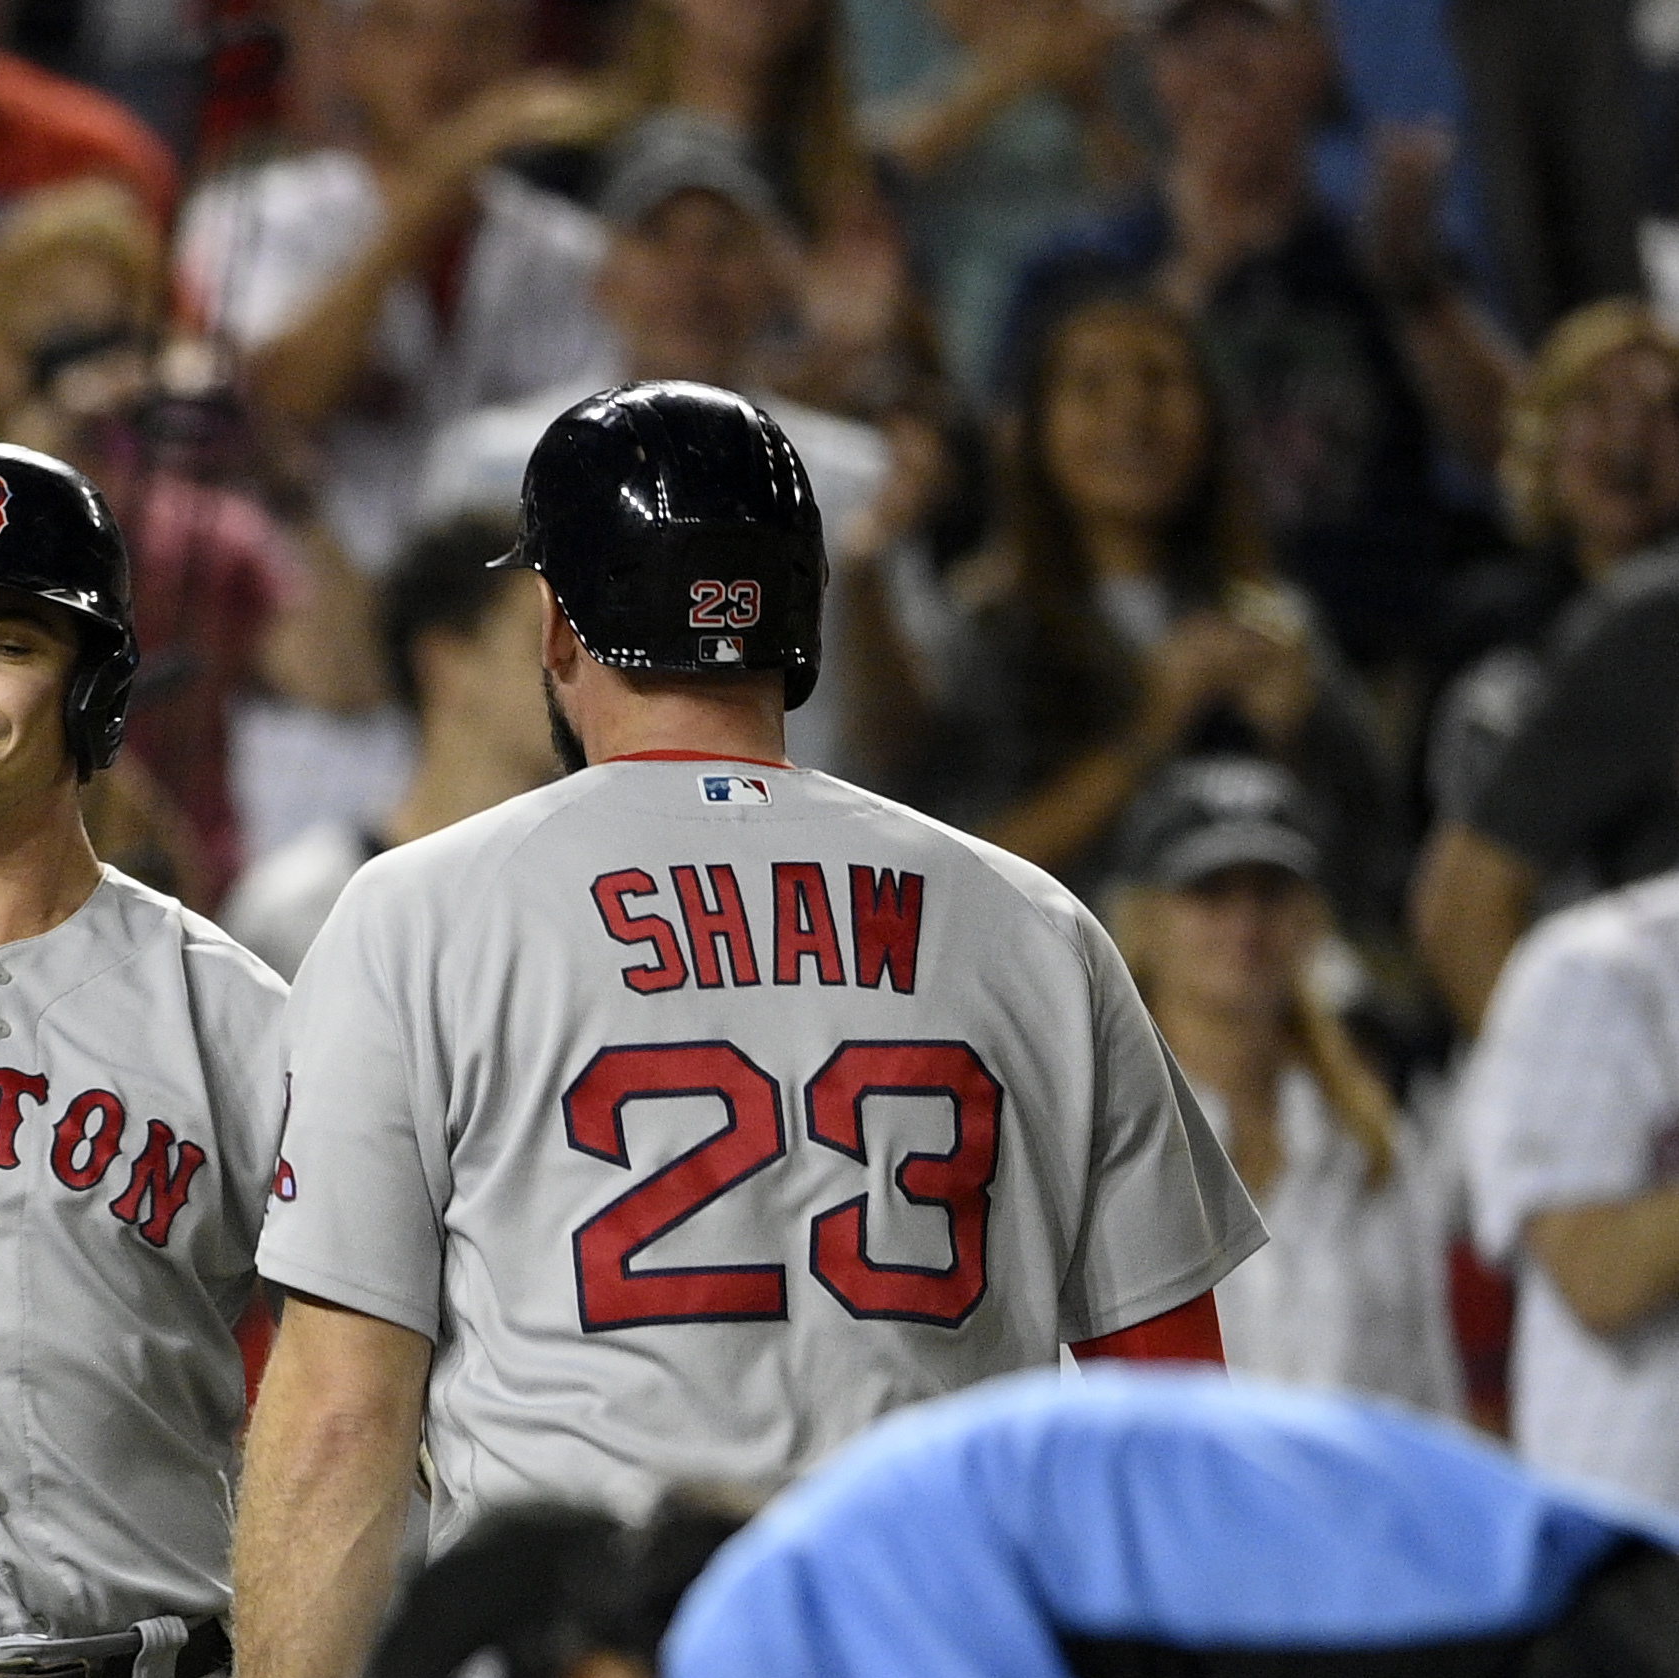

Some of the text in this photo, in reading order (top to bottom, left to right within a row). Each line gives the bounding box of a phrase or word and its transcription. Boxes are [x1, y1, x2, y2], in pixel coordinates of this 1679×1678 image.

[688, 580, 761, 629] 23
[589, 861, 925, 996] SHAW
[561, 1039, 1005, 1335] 23
